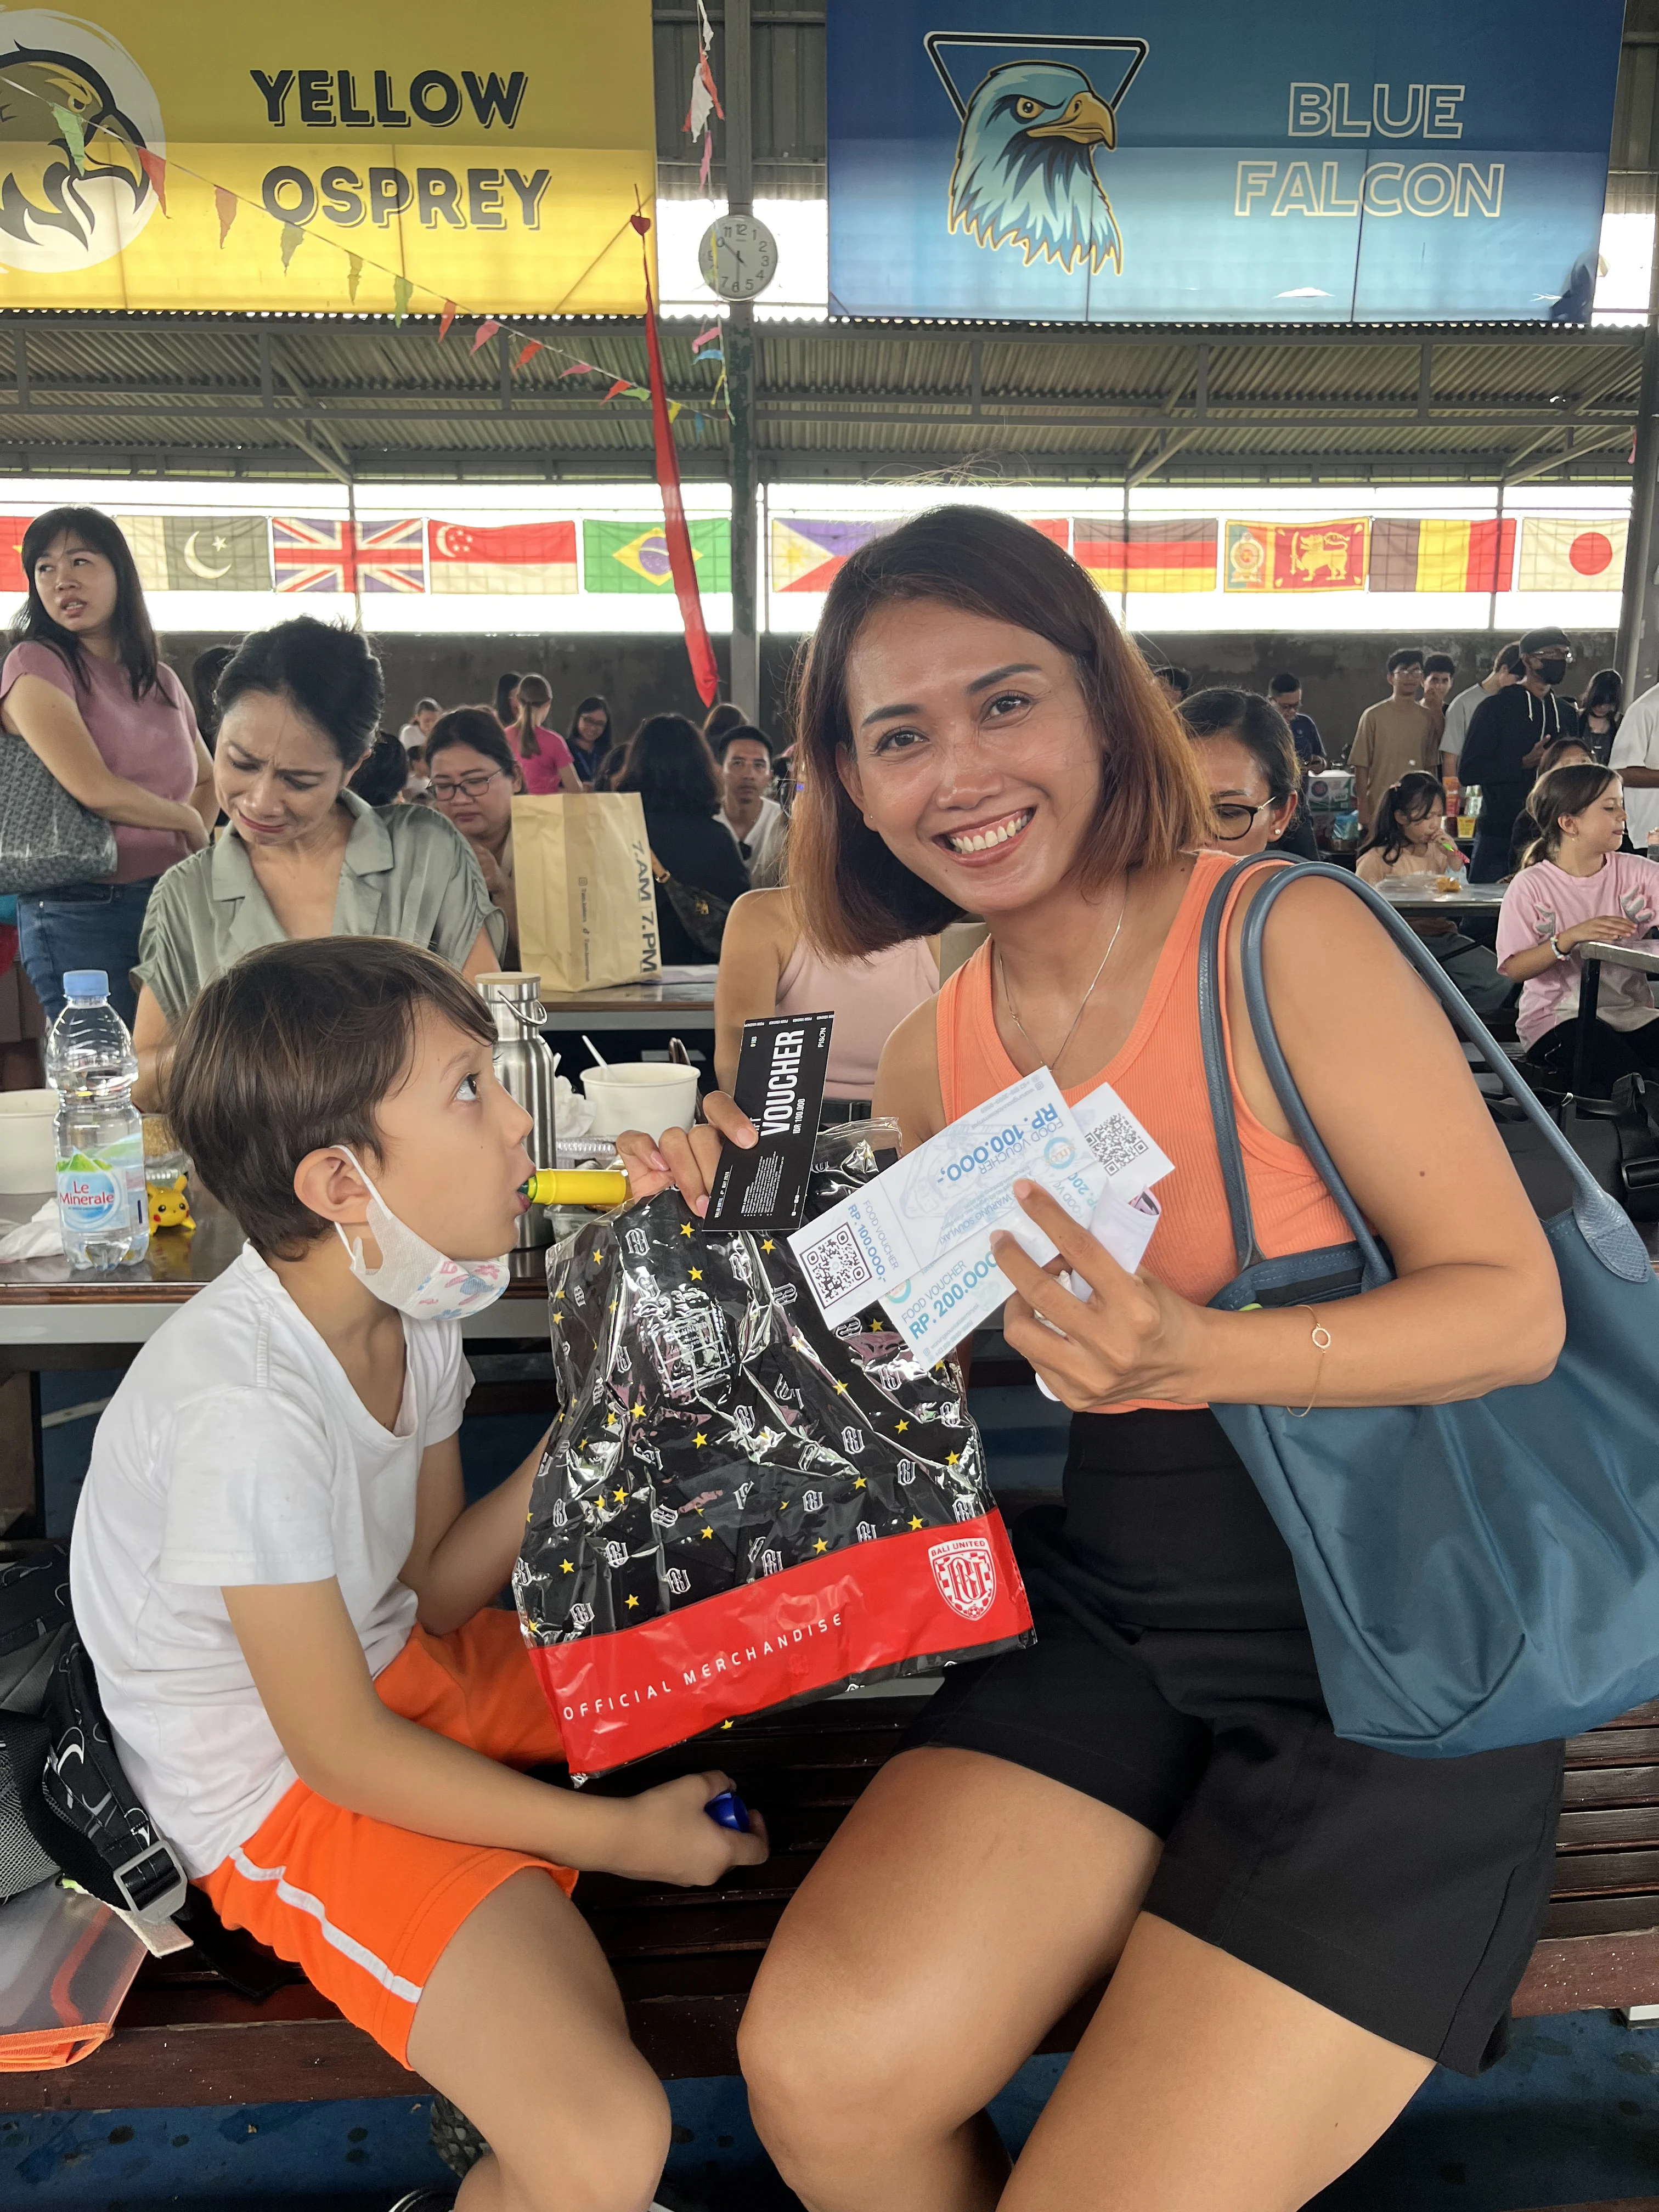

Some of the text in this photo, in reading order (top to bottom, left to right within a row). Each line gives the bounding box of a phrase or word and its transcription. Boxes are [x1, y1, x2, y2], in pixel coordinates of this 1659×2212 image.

[250, 70, 528, 129] YELLOW
[1288, 83, 1464, 139] BLUE
[262, 166, 552, 231] OSPREY
[1235, 160, 1505, 218] FALCON
[736, 224, 747, 235] 12
[759, 241, 767, 252] 2
[755, 270, 764, 280] 4
[761, 256, 769, 267] 3
[722, 276, 729, 287] 7
[745, 279, 754, 290] 5
[632, 840, 658, 973] 7.AM 7.PM
[818, 1027, 827, 1048] PISON
[760, 1030, 805, 1136] VOUCHER
[793, 1098, 805, 1134] IDR 100.000
[1024, 1103, 1058, 1130] RP.
[979, 1118, 1063, 1174] FOOD VOUCHER
[59, 1191, 114, 1205] Minerale
[73, 1181, 89, 1194] Le
[848, 1204, 861, 1225] RP.
[939, 1194, 1011, 1244] WARUNG SOUVLAKI
[864, 1200, 899, 1269] FOOD VOUCHER
[901, 1297, 927, 1323] FOOD
[928, 1260, 967, 1299] VOUCHER
[909, 1313, 936, 1339] RP.
[931, 1541, 985, 1556] BALI UNITED
[563, 1613, 842, 1721] OFFICIAL MERCHANDISE
